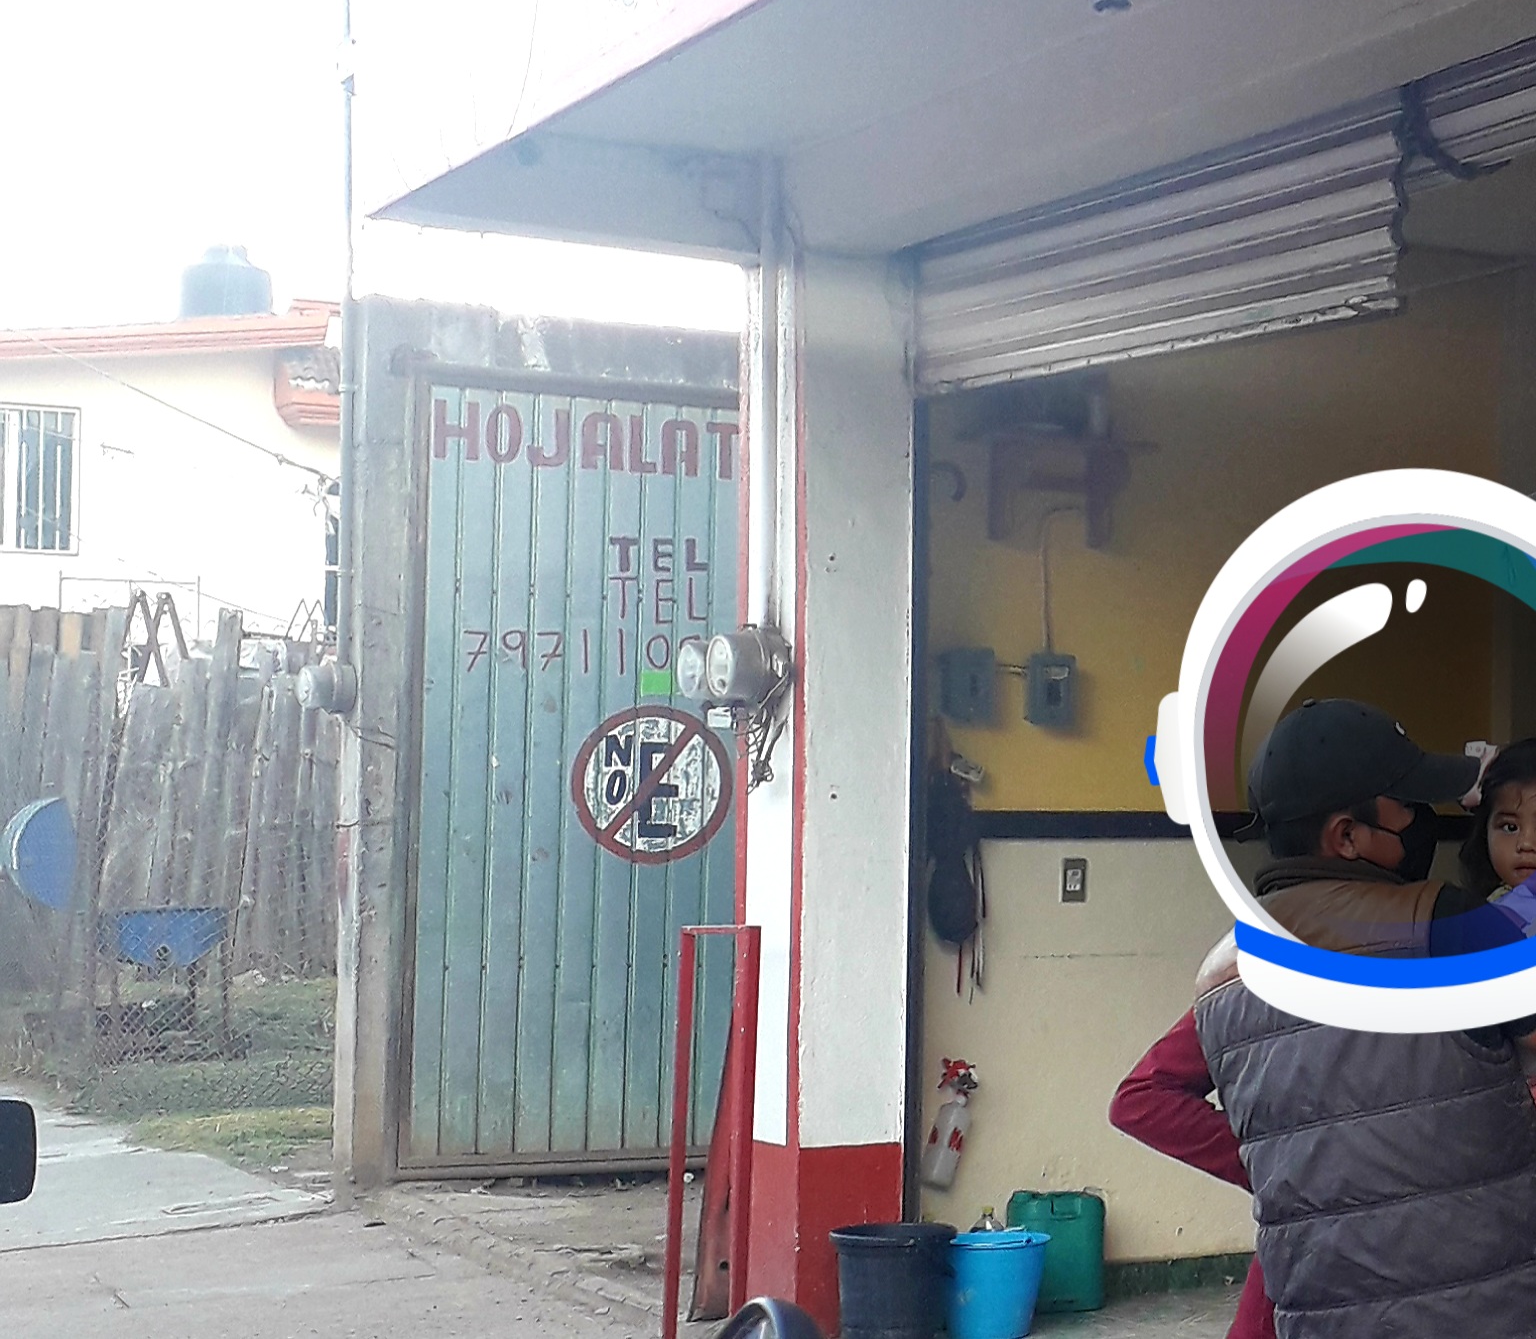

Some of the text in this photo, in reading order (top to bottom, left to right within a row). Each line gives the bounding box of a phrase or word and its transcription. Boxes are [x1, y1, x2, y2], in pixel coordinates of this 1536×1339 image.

[609, 536, 709, 572] TEL
[609, 576, 708, 625] TEL
[463, 628, 702, 676] 797110
